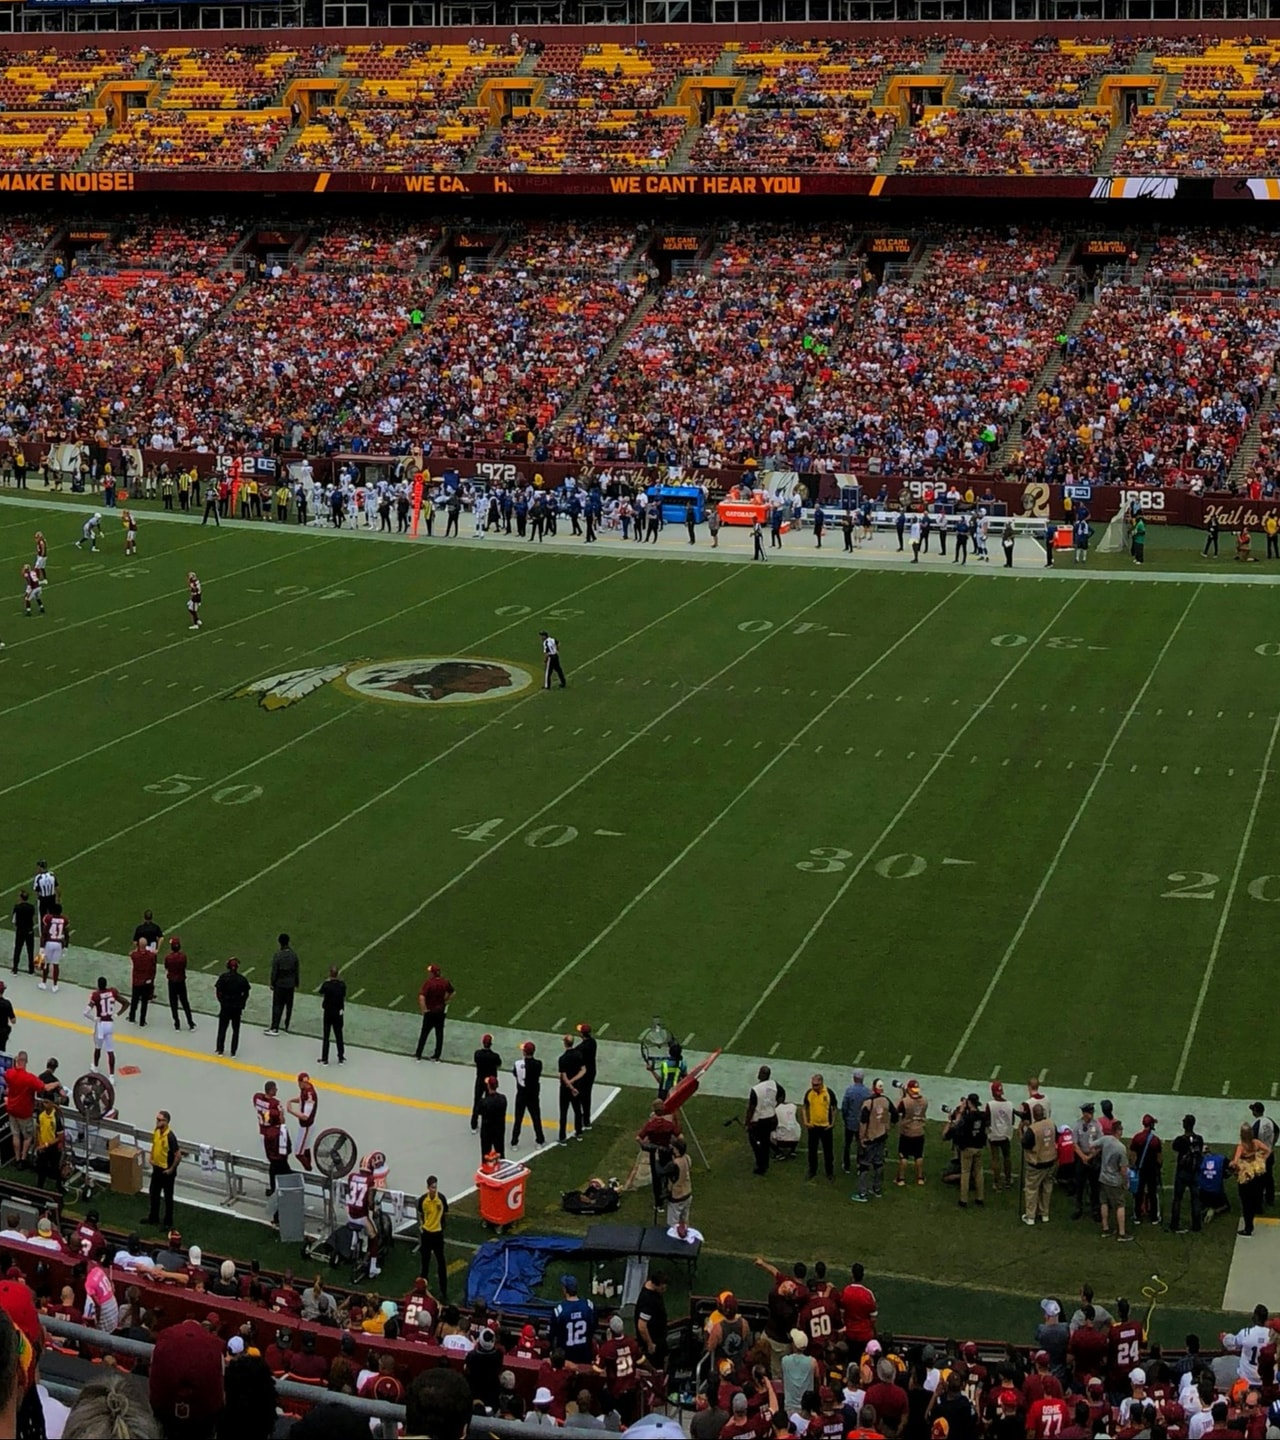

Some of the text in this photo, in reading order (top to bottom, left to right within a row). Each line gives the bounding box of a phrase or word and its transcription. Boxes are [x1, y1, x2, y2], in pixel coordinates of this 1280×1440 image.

[60, 172, 134, 191] NOISE!
[404, 176, 435, 192] WE
[609, 177, 641, 193] WE
[645, 177, 698, 193] CANT
[703, 177, 756, 193] HEAR
[760, 177, 801, 193] YOU
[663, 243, 682, 251] HEAR
[894, 245, 910, 253] YOU
[475, 463, 516, 481] 1972
[1203, 505, 1260, 530] Hail to
[143, 773, 264, 806] 50
[450, 817, 579, 849] 40
[795, 846, 928, 880] 30
[348, 1181, 369, 1208] 37
[508, 1183, 524, 1211] G
[566, 1319, 587, 1346] 12
[810, 1314, 831, 1338] 60
[1118, 1340, 1140, 1365] 24
[1042, 1404, 1062, 1416] OSHIE
[1041, 1413, 1063, 1436] 77
